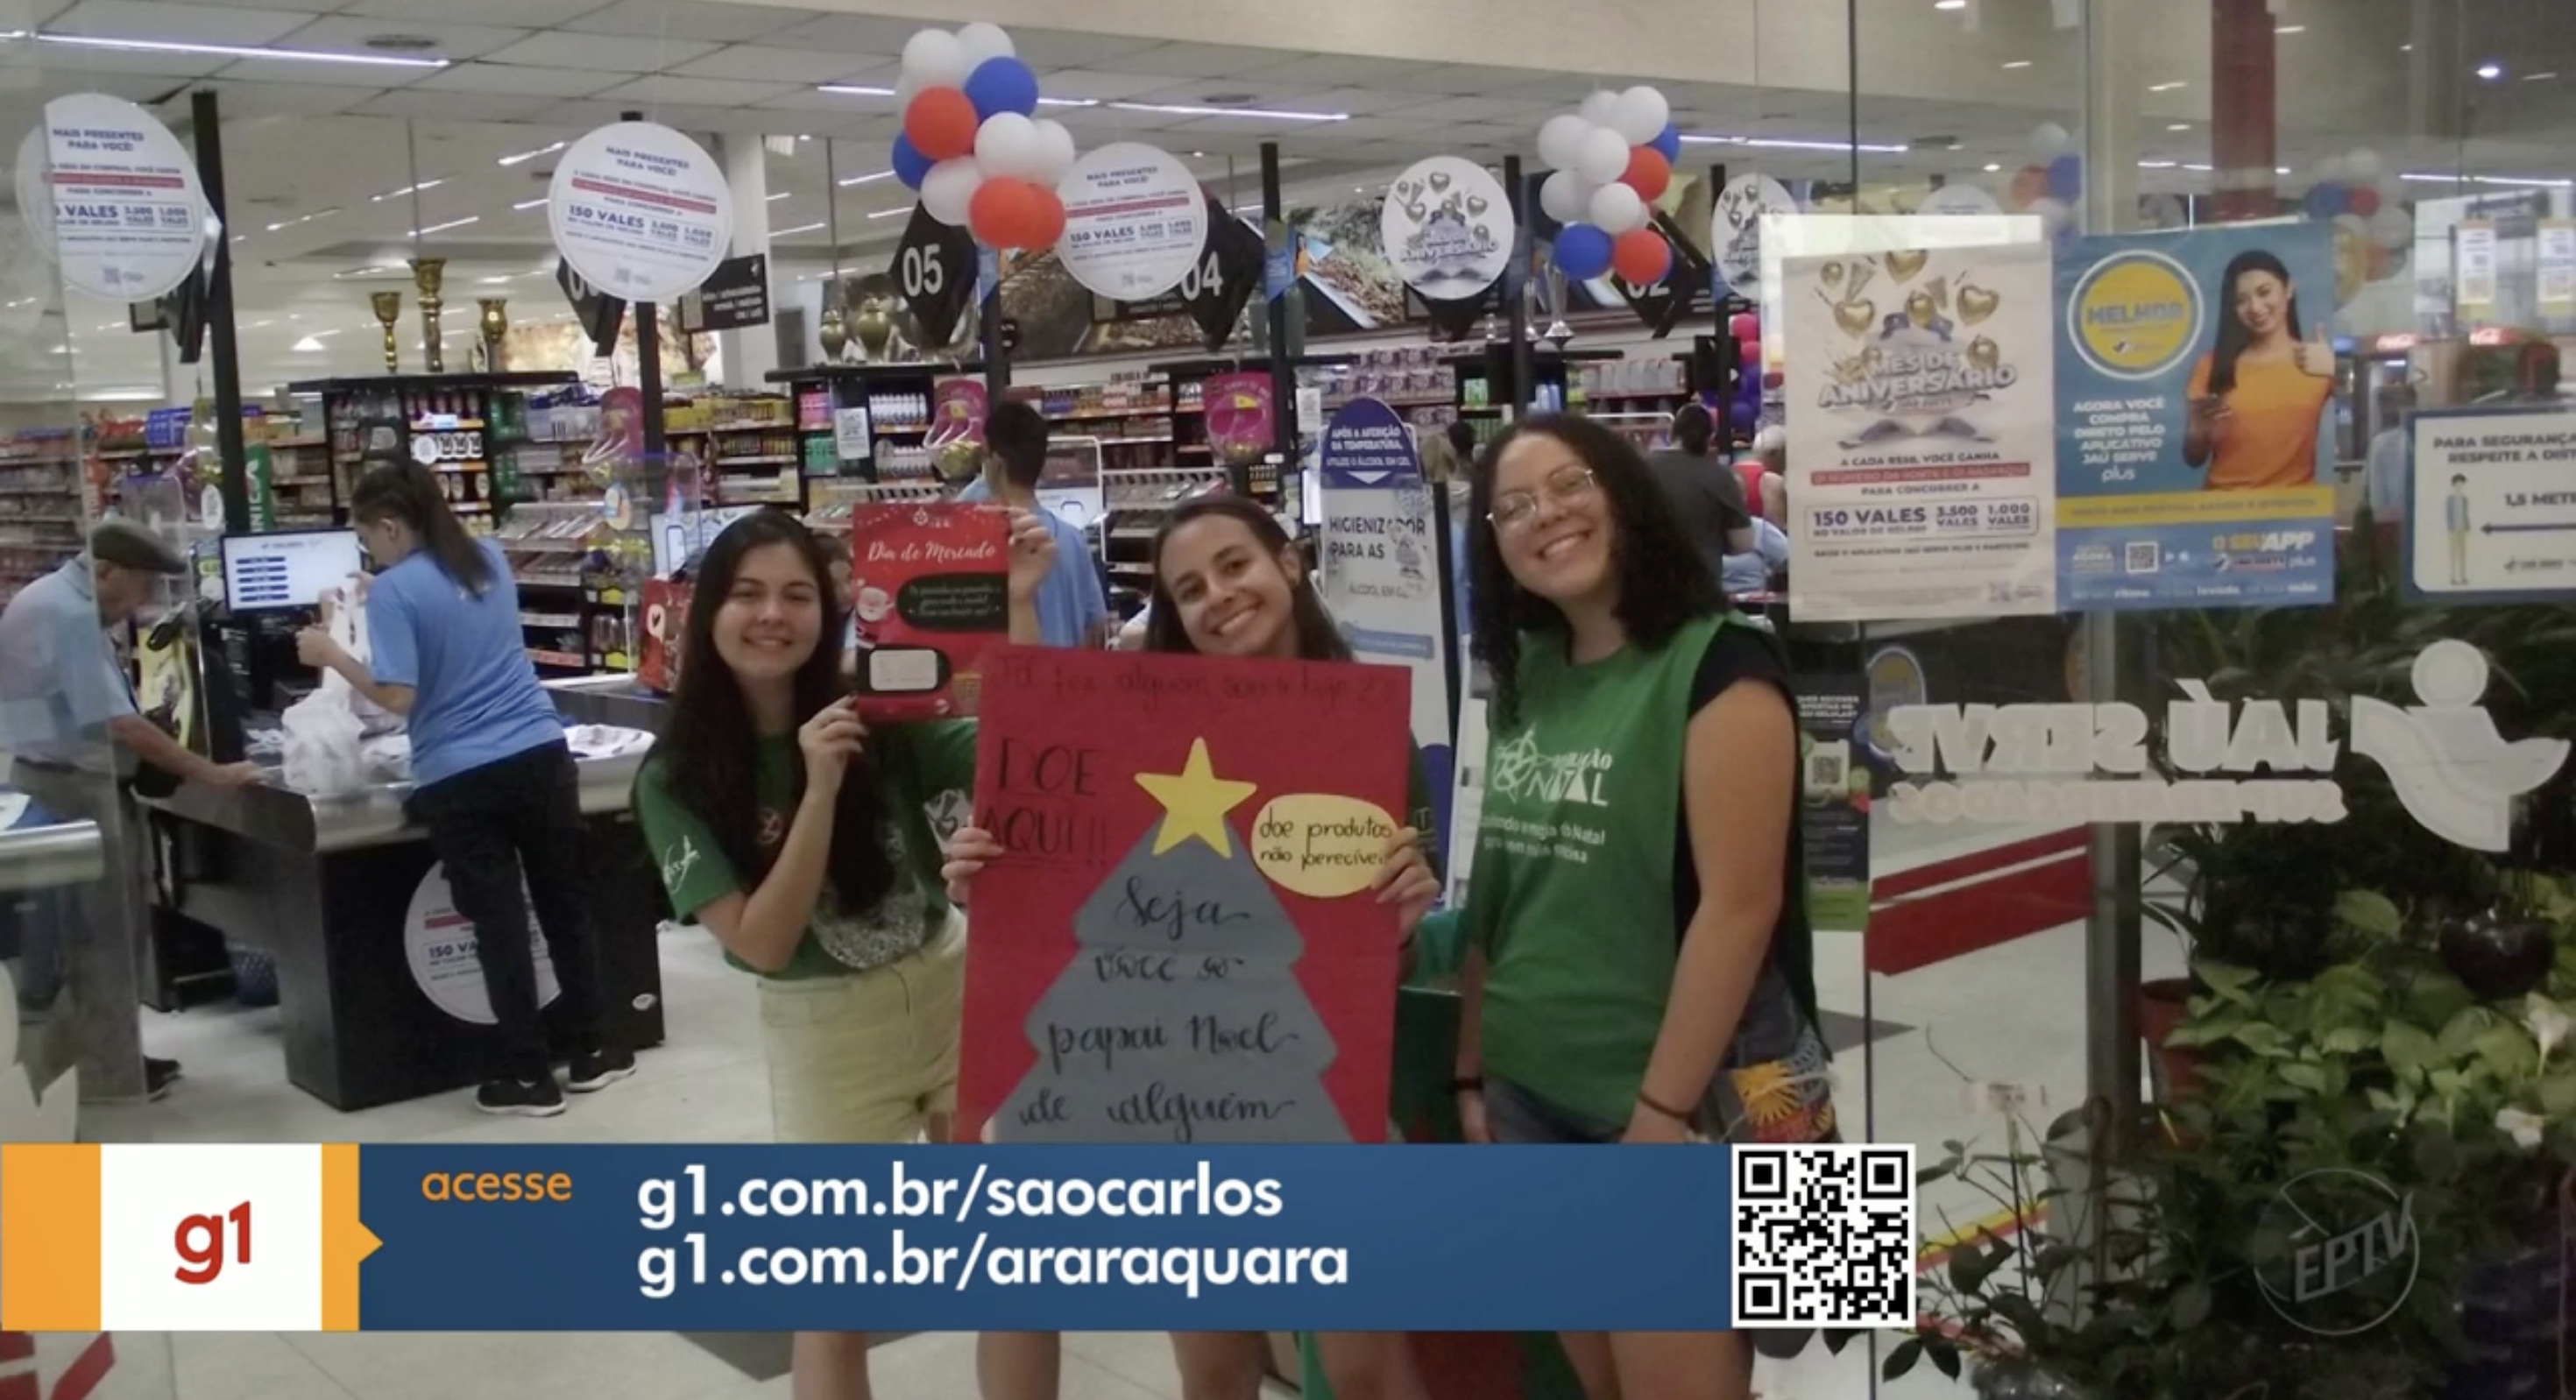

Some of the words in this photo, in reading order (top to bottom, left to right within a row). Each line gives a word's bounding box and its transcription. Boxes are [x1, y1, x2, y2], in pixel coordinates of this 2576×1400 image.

[65, 205, 118, 218] VALES
[570, 205, 592, 218] 150
[598, 209, 644, 229] VALES
[1071, 232, 1091, 243] 150
[1094, 226, 1135, 240] VALES
[902, 244, 943, 297] 05
[1180, 251, 1222, 301] 04
[2073, 400, 2123, 412] AGORA
[2125, 396, 2165, 409] VOCÊ
[2089, 412, 2149, 425] COMPRA
[2128, 423, 2166, 435] PELO
[2080, 437, 2162, 451] APLICATIVO
[2433, 436, 2477, 449] PARA
[2448, 450, 2522, 463] RESPEITE
[2527, 449, 2537, 460] A
[2102, 464, 2136, 483] plus
[2505, 492, 2526, 507] 1,5
[1814, 511, 1849, 527] 150
[1856, 507, 1927, 525] VALES
[1936, 505, 1978, 517] 3.500
[1988, 503, 2030, 515] 1.000
[1936, 517, 1978, 527] VALES
[1988, 514, 2030, 526] VALES
[1329, 517, 1426, 534] HIGIENIZOR
[867, 541, 895, 562] Dia
[901, 543, 920, 561] de
[924, 541, 995, 564] Mercado
[1330, 541, 1366, 559] PARA
[1368, 541, 1385, 559] AS
[998, 736, 1106, 795] DOE
[1260, 805, 1294, 838] doe
[1306, 816, 1393, 855] produtos
[1260, 846, 1293, 862] não
[1301, 849, 1387, 872] perecívei
[1115, 875, 1251, 941] Seja
[428, 945, 453, 958] 150
[1049, 1021, 1168, 1075] papai
[1186, 1010, 1299, 1055] Noel
[1019, 1088, 1072, 1126] de
